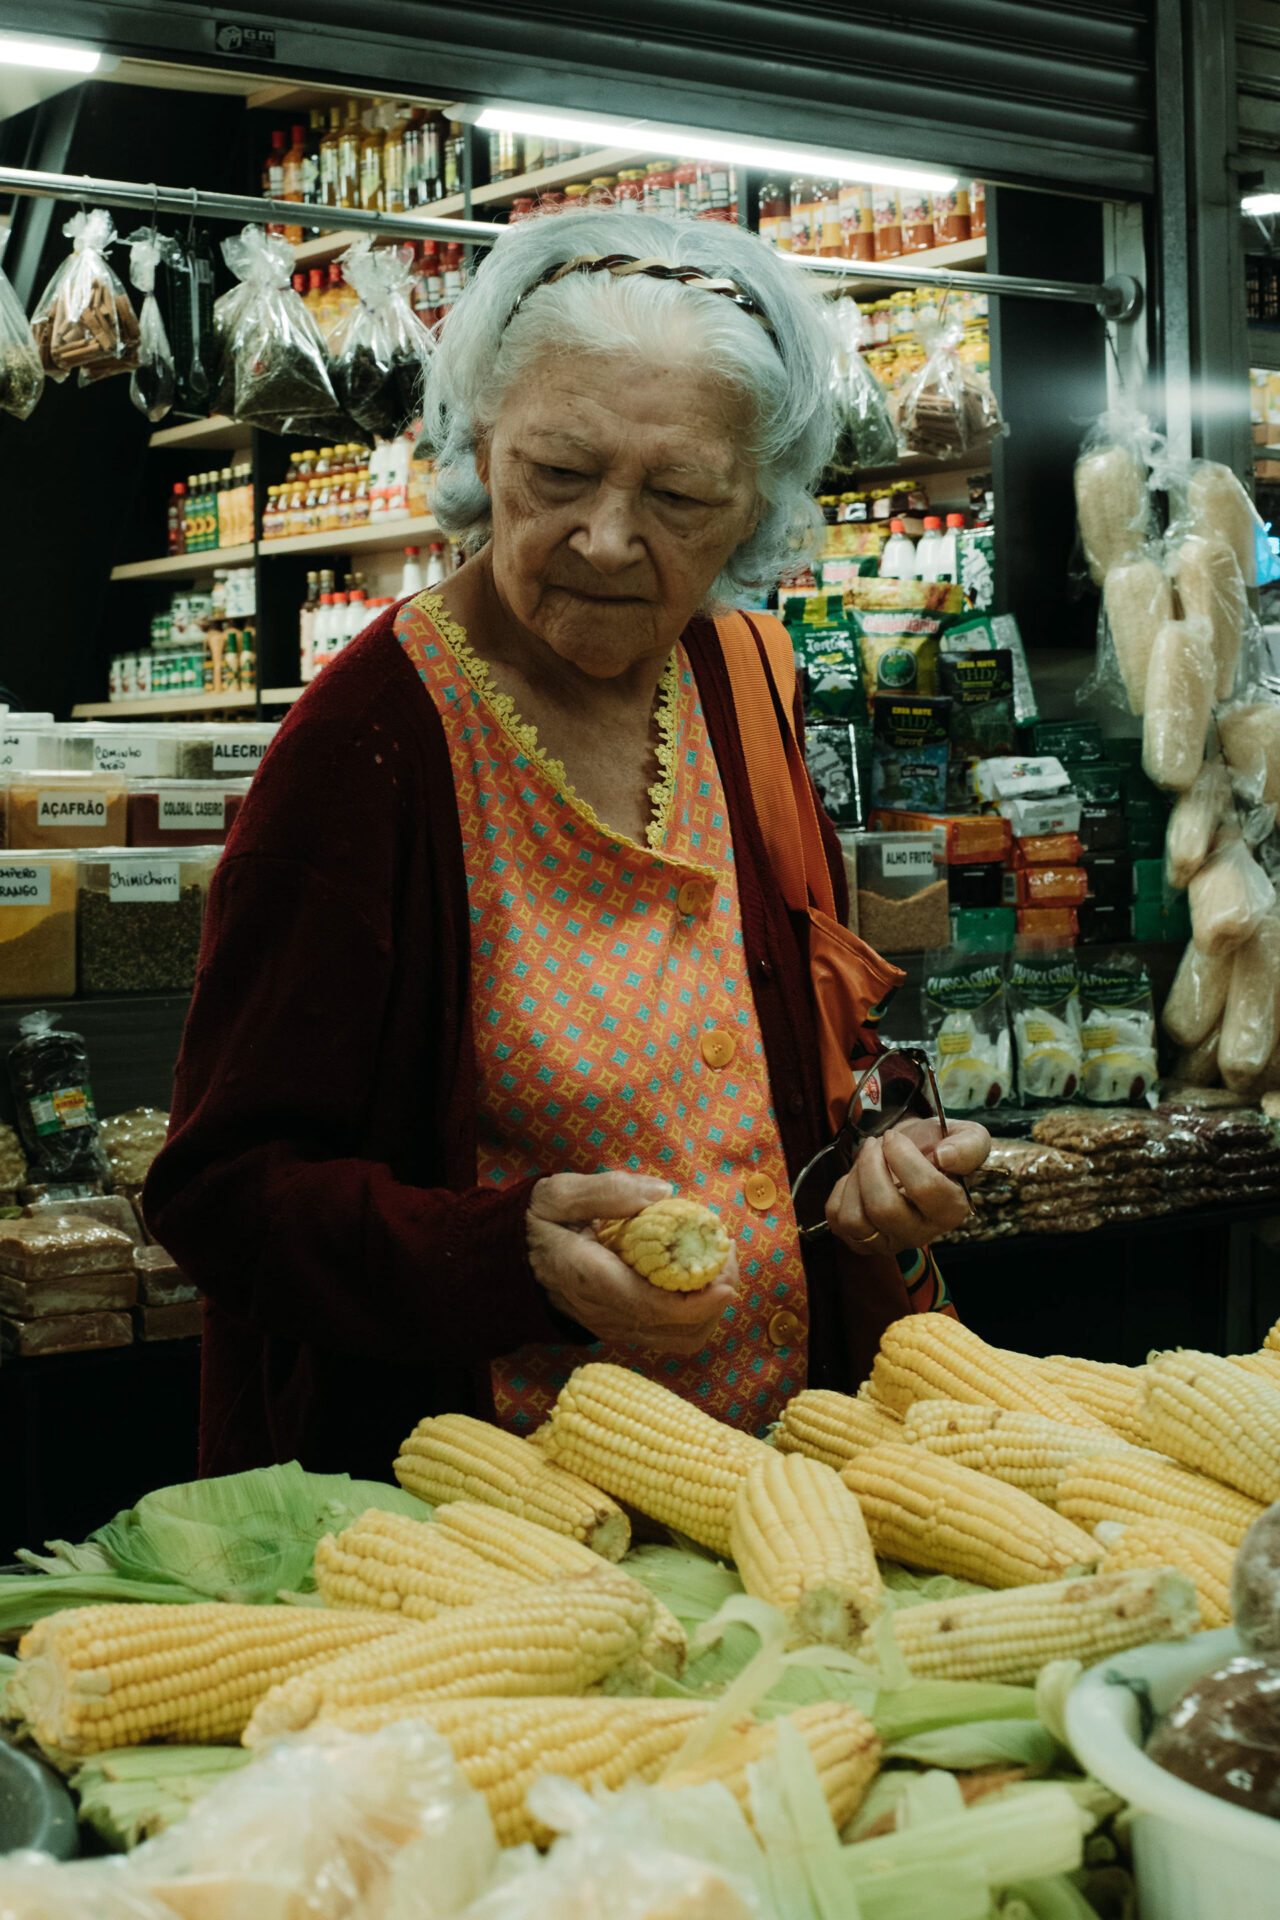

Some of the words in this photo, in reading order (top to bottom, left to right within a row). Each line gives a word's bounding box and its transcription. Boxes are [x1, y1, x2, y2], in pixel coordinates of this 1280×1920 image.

[41, 800, 104, 819] AÇAFRÃO
[163, 801, 193, 816] COLORAL
[195, 801, 223, 816] CASEIRO
[886, 851, 907, 865] ALHO
[909, 850, 933, 864] FRITO
